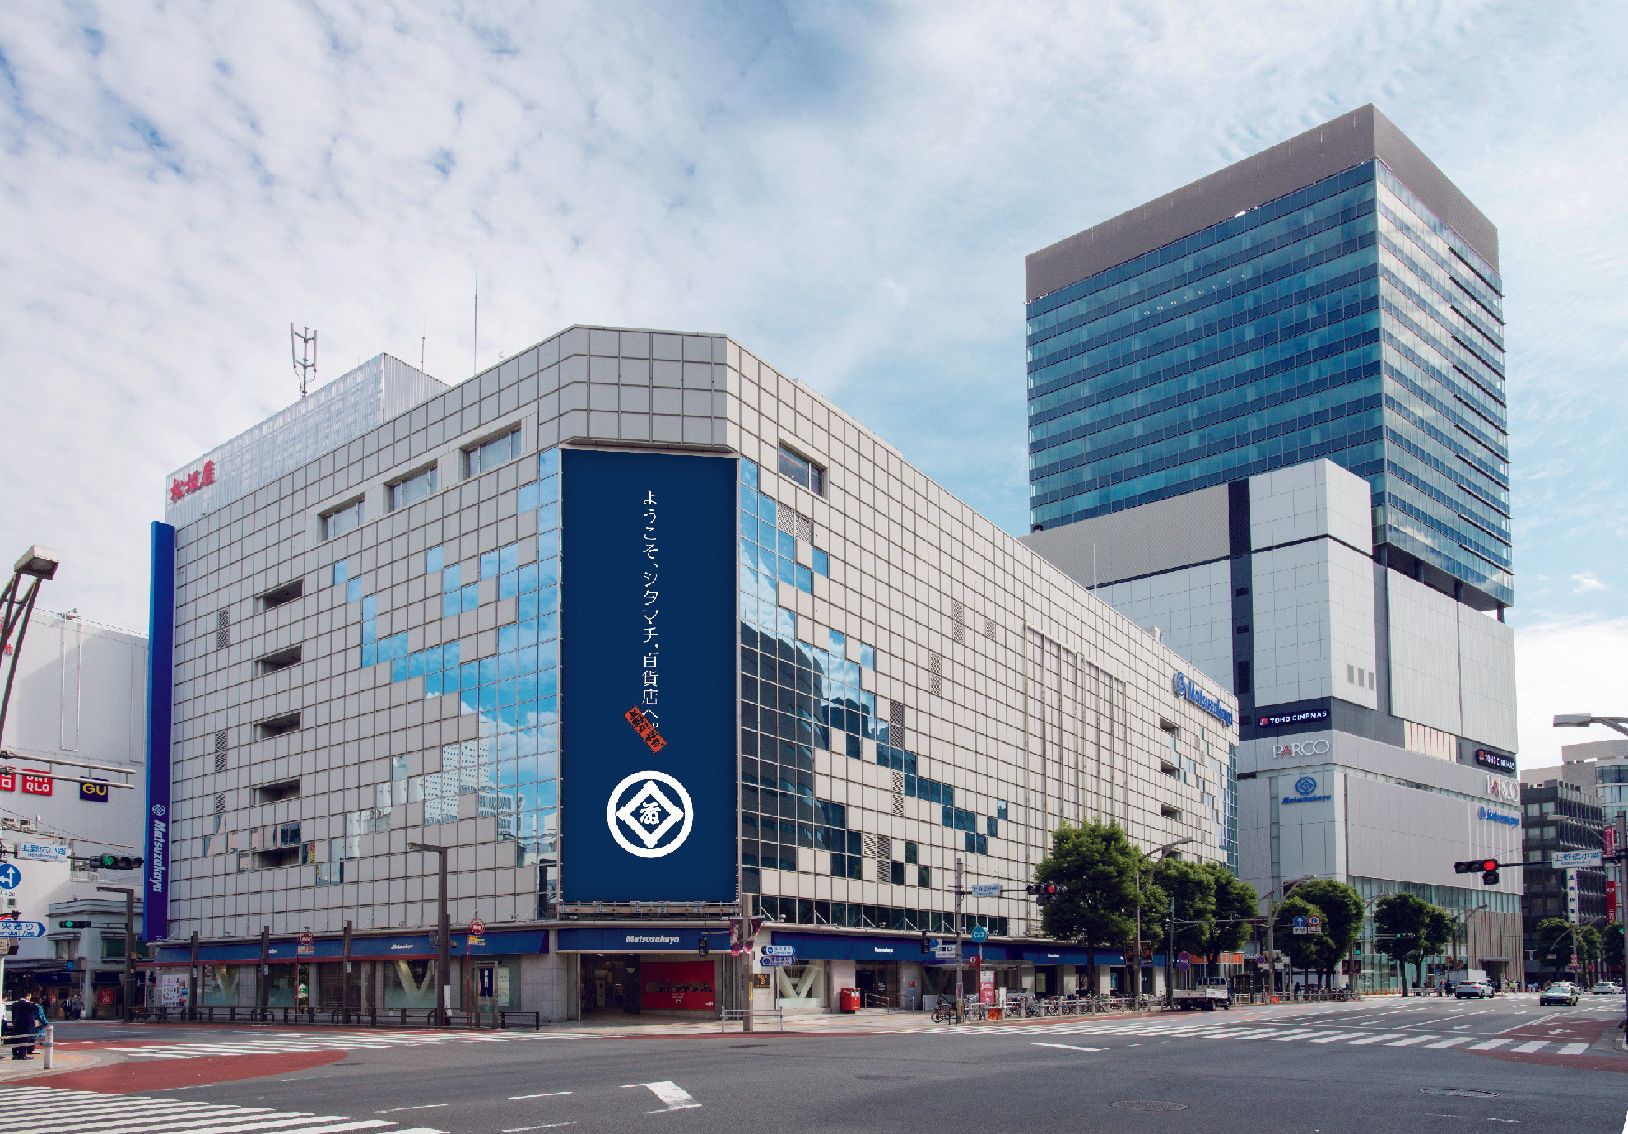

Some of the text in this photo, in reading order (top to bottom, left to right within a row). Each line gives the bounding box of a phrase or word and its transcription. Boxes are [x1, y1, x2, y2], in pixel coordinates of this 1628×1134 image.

[1187, 680, 1233, 727] Matsuzakaya
[1270, 711, 1327, 724] TOHO CINEMAS
[1272, 739, 1329, 759] PARCO
[26, 782, 50, 792] QLO
[82, 783, 107, 796] GU
[150, 819, 166, 893] Matsuzakaya
[625, 935, 680, 945] Matsuzakaya
